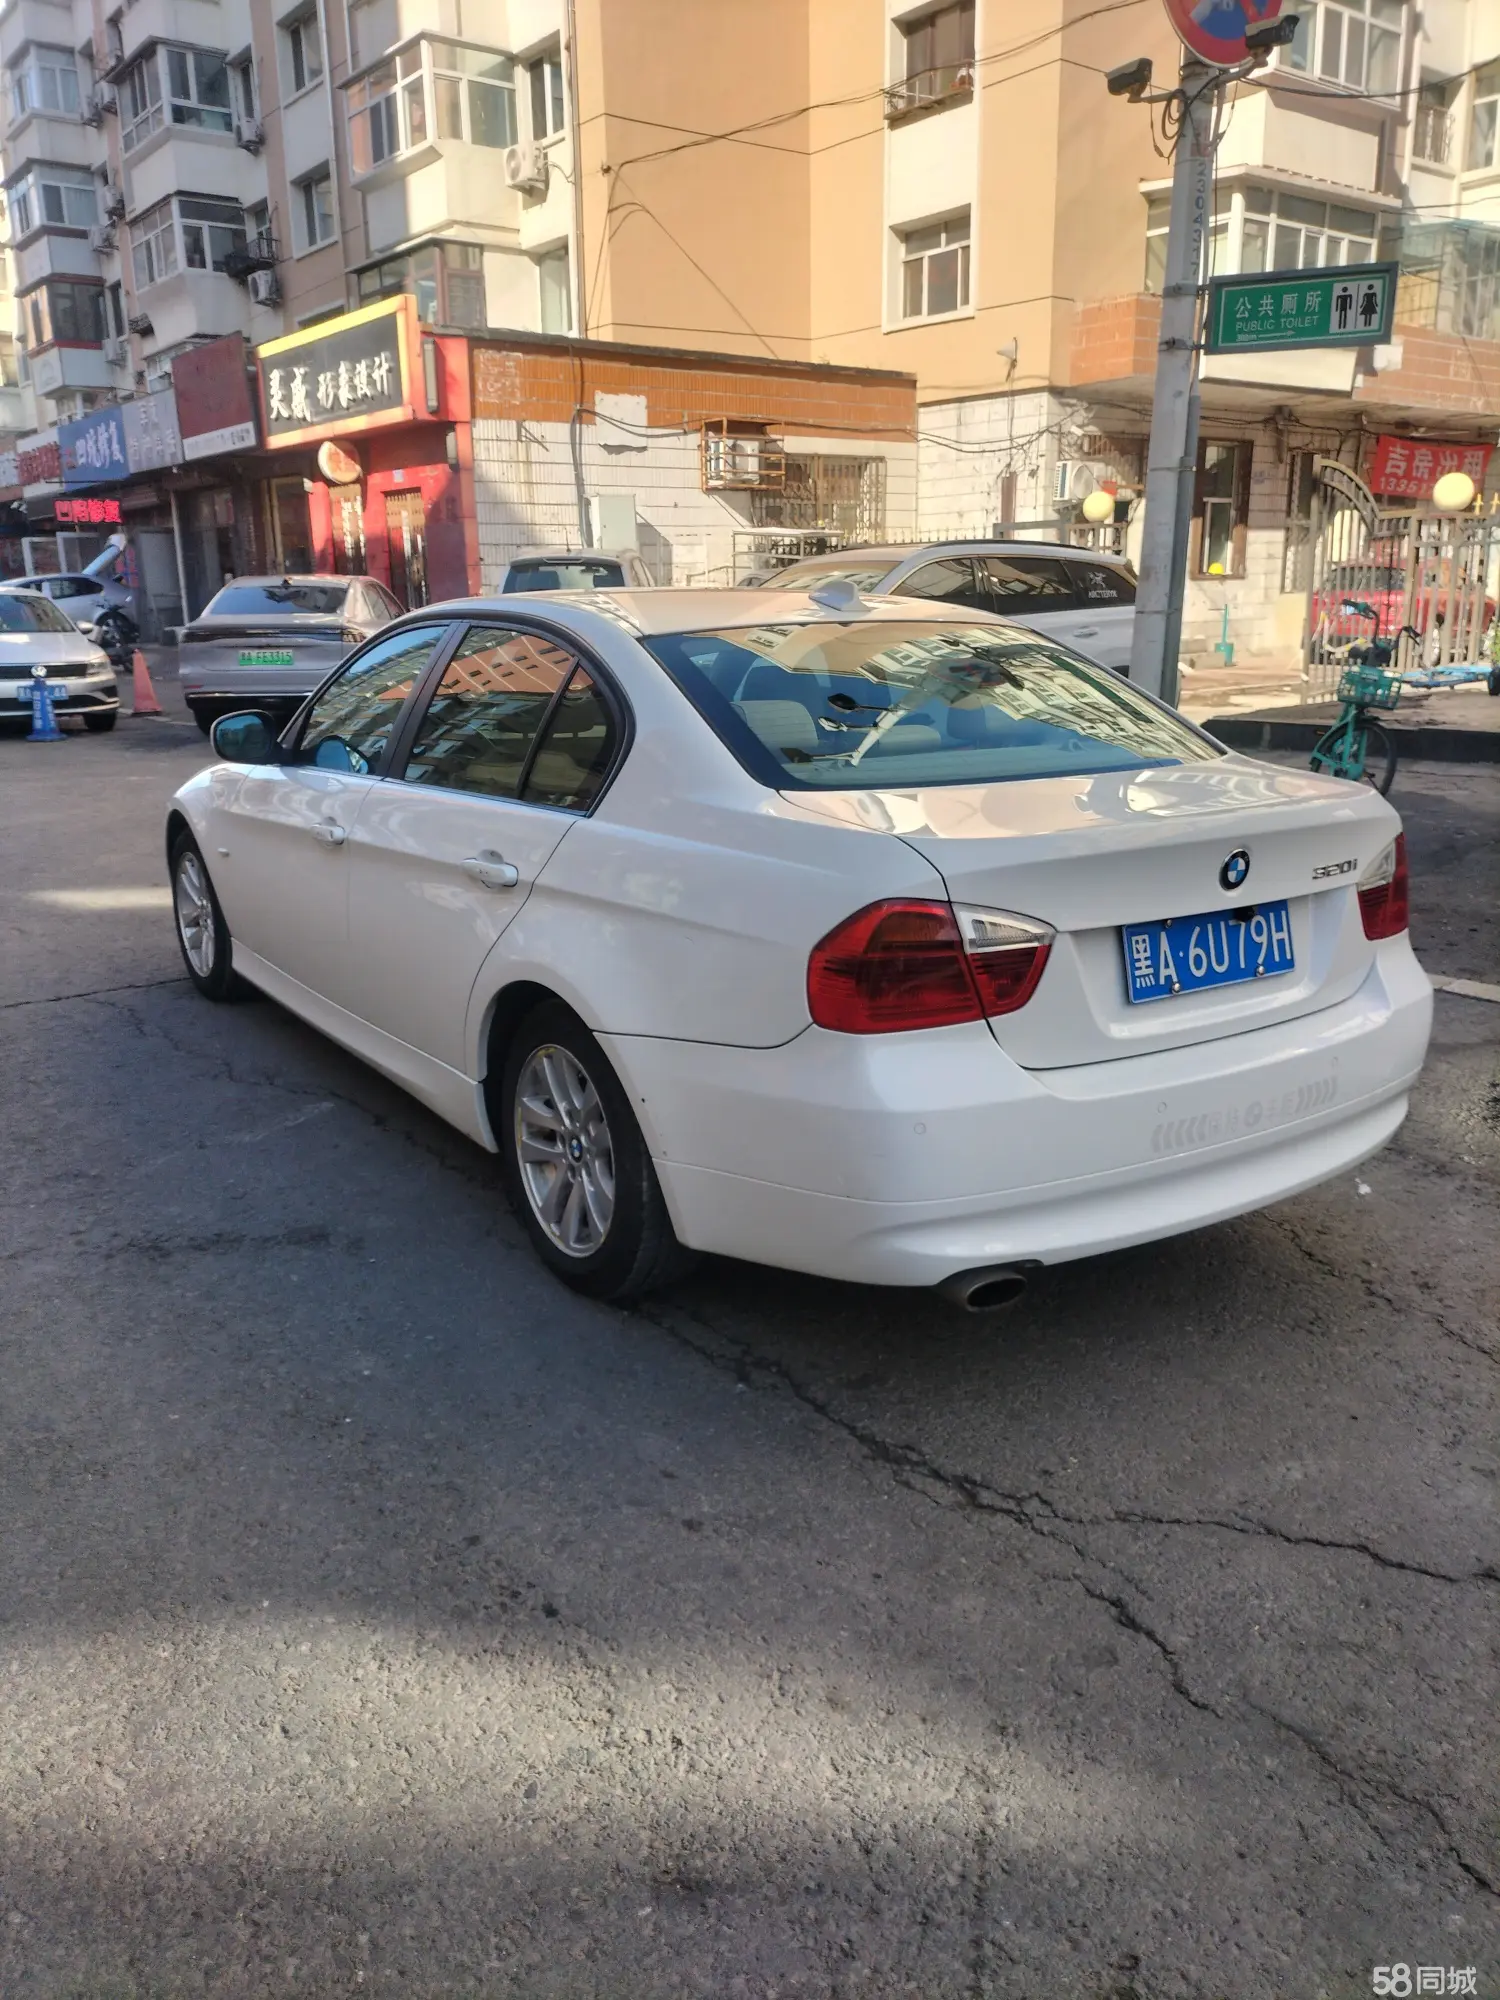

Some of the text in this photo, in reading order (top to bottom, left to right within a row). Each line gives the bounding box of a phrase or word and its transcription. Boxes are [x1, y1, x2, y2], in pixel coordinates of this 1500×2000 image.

[1234, 290, 1323, 319] 公共厕所
[1235, 315, 1321, 332] PUBLIC TOILET
[1384, 444, 1485, 482] 吉房出租
[1312, 858, 1358, 881] 320i
[1131, 910, 1292, 989] 黑A·6U79H
